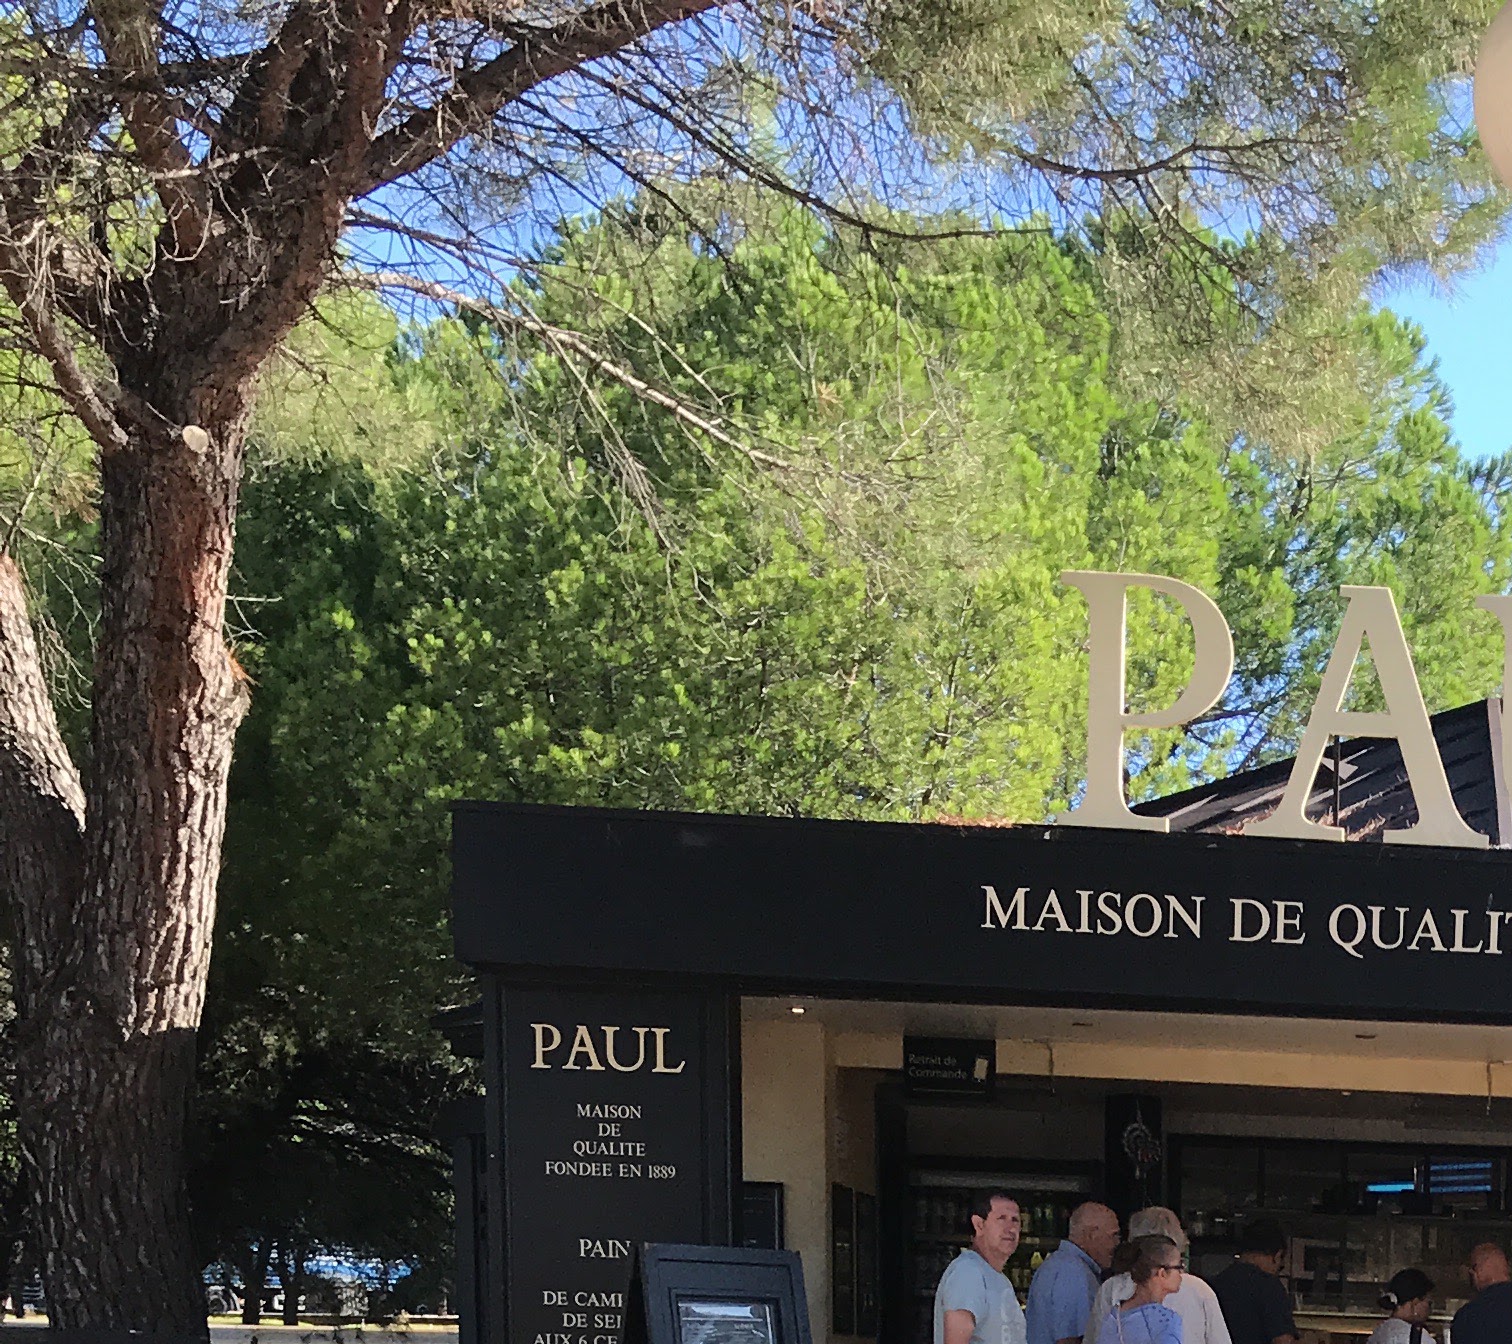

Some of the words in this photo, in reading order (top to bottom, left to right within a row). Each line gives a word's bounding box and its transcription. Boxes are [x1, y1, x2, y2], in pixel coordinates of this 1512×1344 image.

[981, 886, 1205, 938] MAISON
[1229, 899, 1305, 944] DE
[531, 1024, 685, 1073] PAUL
[577, 1104, 641, 1118] MAISON
[599, 1123, 620, 1136] DE
[574, 1141, 645, 1156] QUALITE
[546, 1162, 612, 1176] FONDEE
[619, 1164, 641, 1177] EN
[649, 1166, 675, 1178] 1889
[543, 1291, 568, 1305] DE
[563, 1313, 588, 1327] DE
